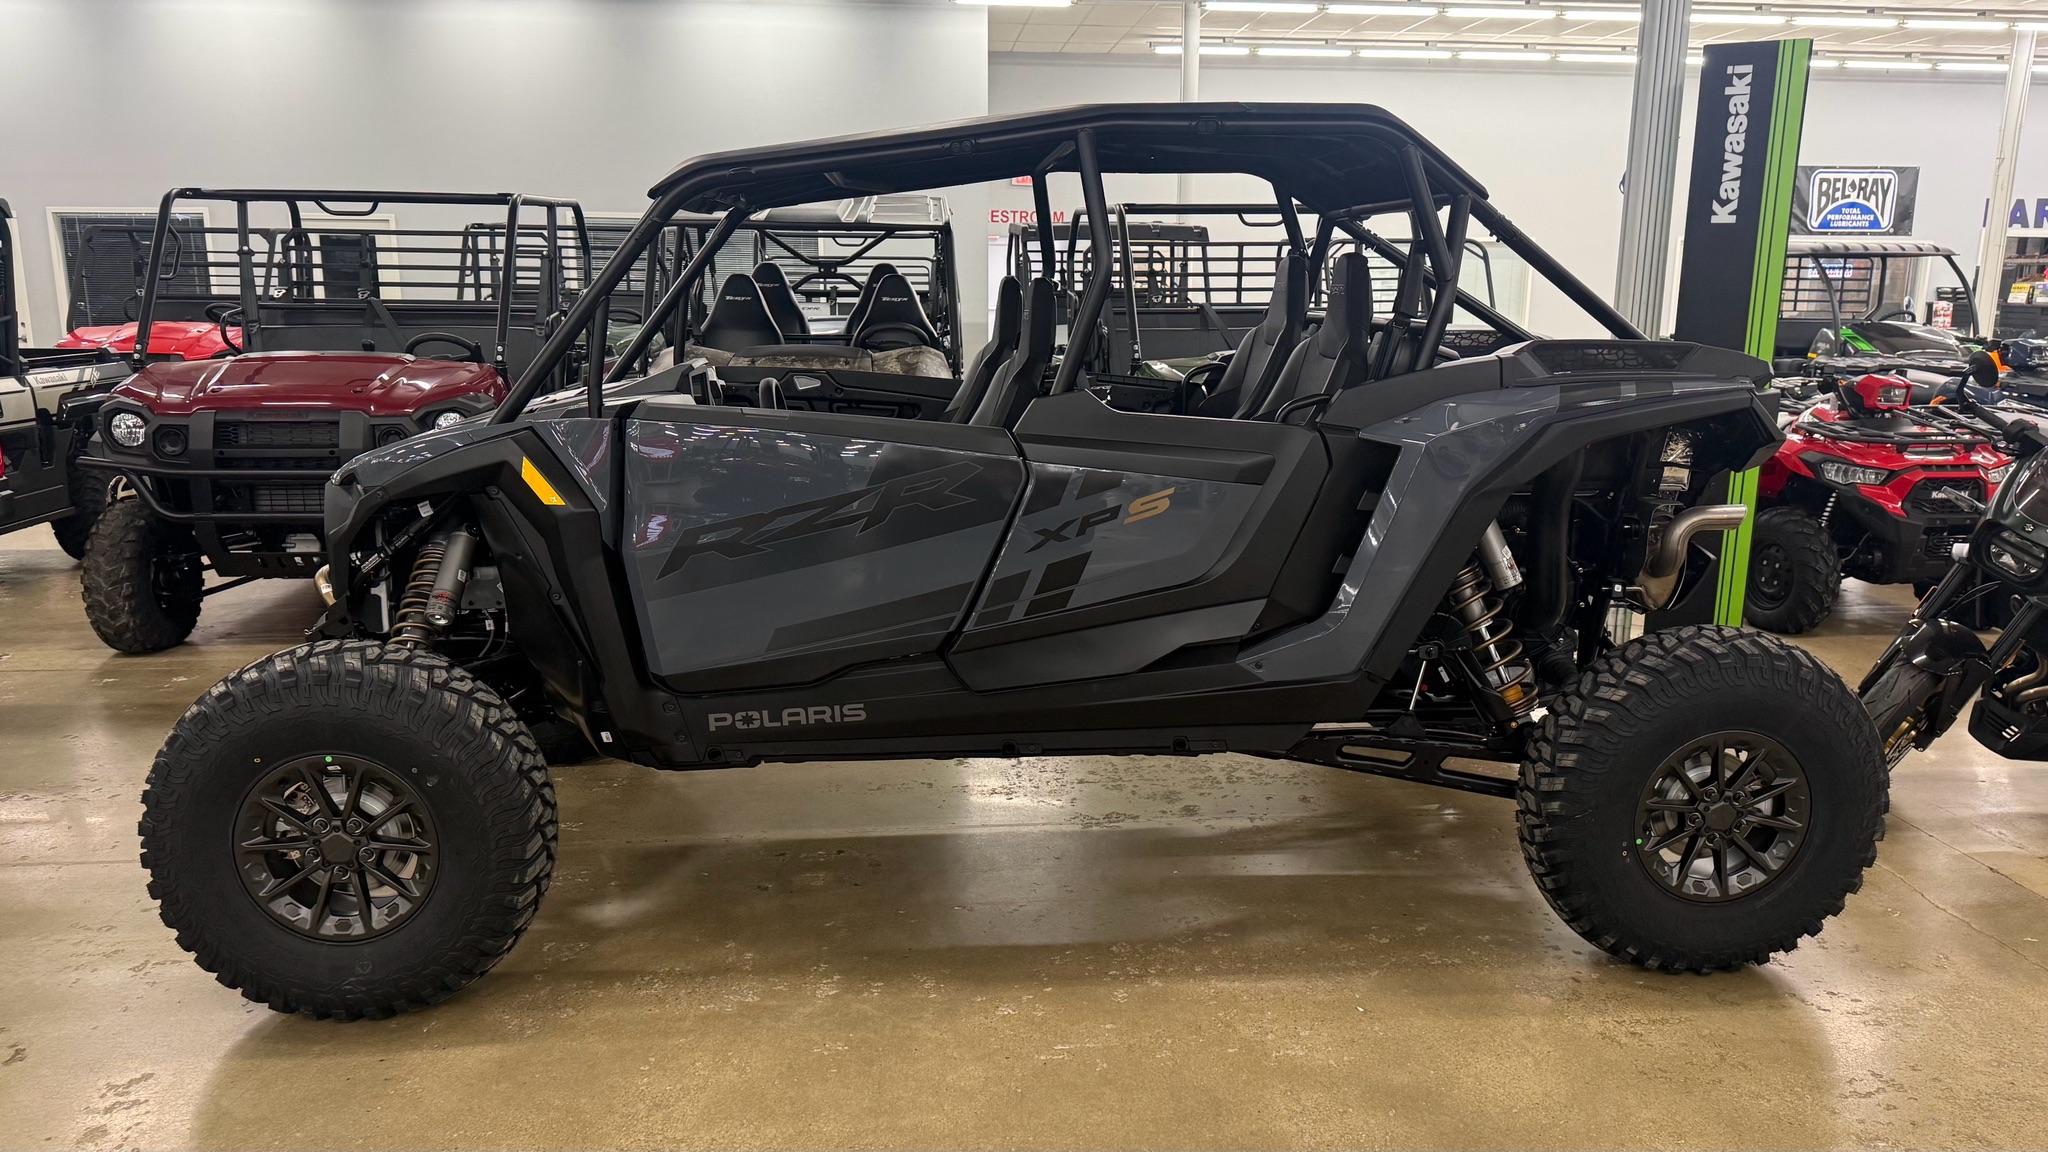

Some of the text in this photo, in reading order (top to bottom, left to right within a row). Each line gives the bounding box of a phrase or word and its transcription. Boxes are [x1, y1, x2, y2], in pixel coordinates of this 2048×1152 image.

[1710, 64, 1754, 224] Kawasaki
[1815, 177, 1893, 223] BEL RAY
[1982, 198, 2048, 228] AR
[33, 373, 68, 385] Kawasaki
[654, 461, 984, 583] RZR
[708, 703, 867, 732] POLARIS
